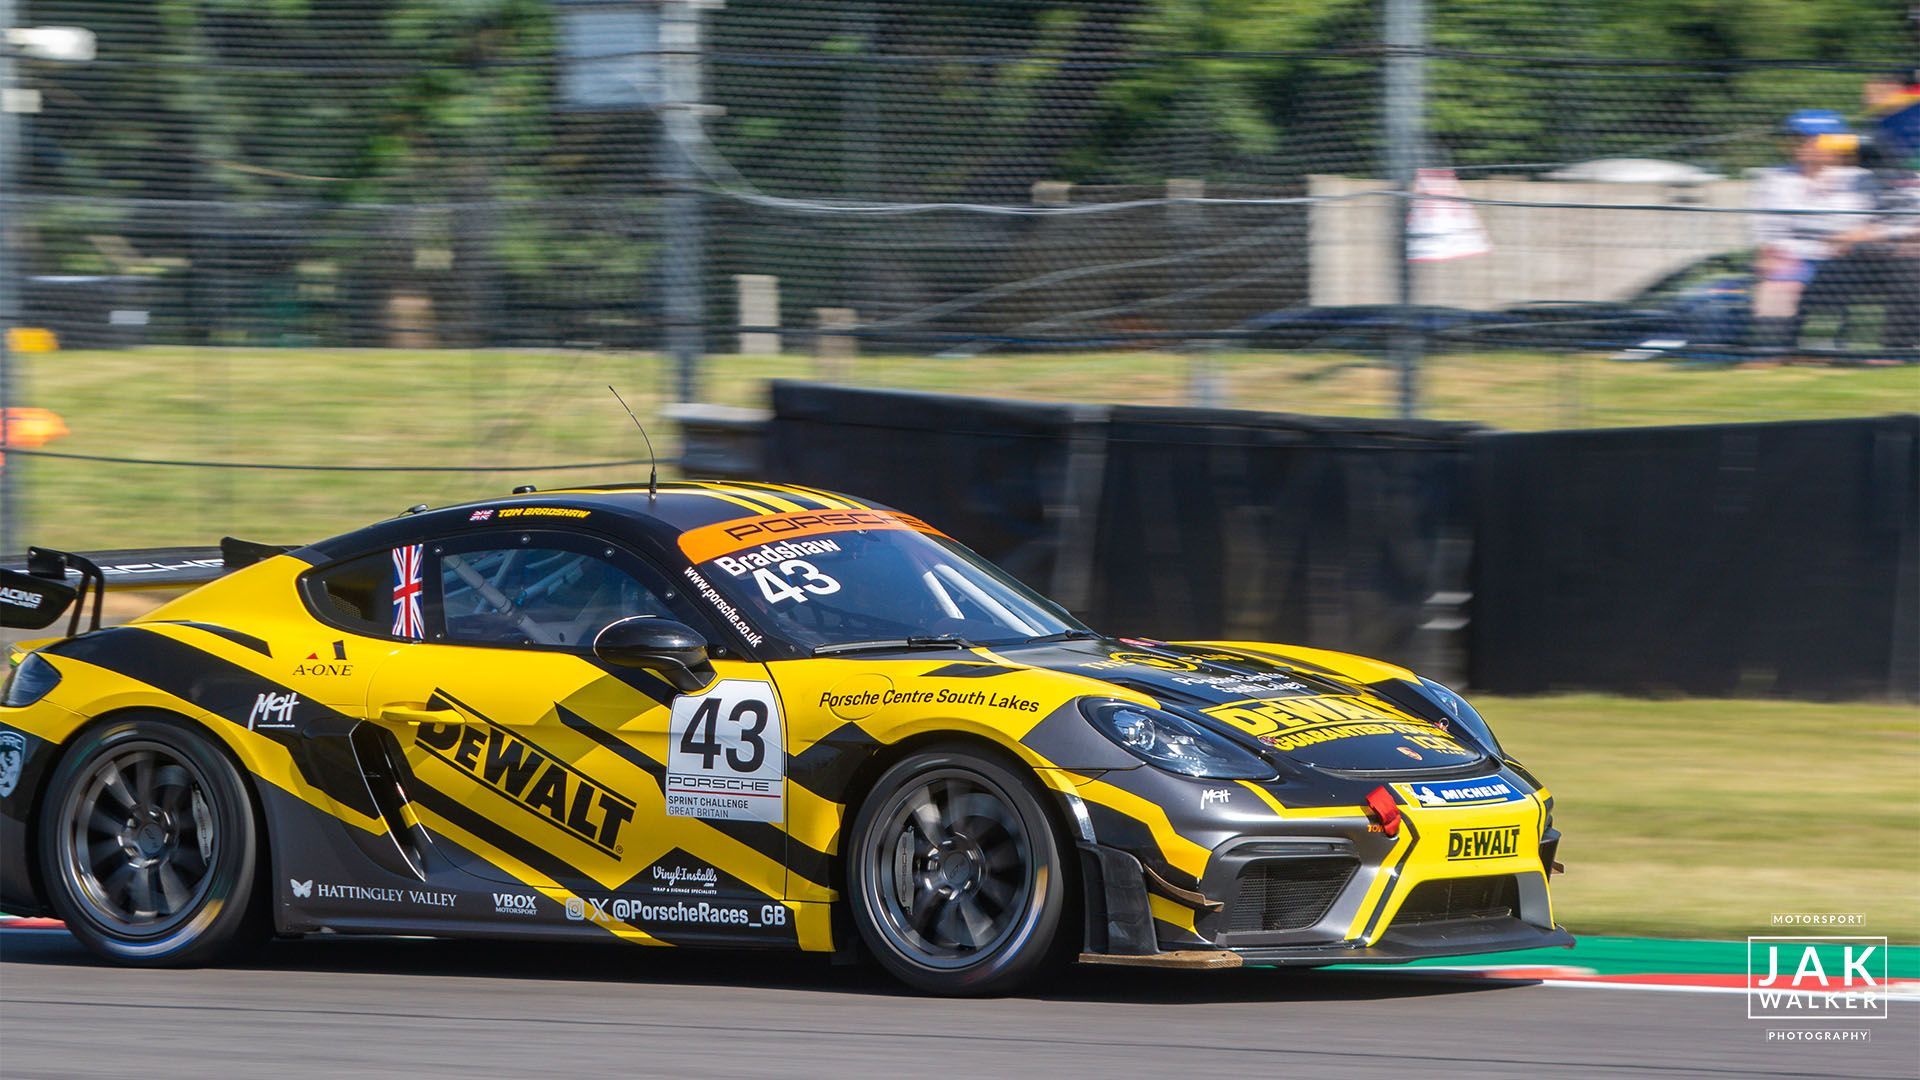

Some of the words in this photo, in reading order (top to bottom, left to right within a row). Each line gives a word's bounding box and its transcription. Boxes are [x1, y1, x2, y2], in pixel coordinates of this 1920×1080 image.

[498, 508, 523, 518] TOM
[523, 507, 592, 519] BRADSHAW
[724, 513, 932, 541] PORSCHE
[713, 538, 842, 578] Bradshaw
[751, 559, 842, 605] 43
[0, 586, 43, 605] ACING
[684, 566, 764, 649] www.porsche.co.uk
[292, 664, 354, 677] A-ONE
[819, 690, 880, 708] Porsche
[882, 689, 934, 705] Centre
[936, 689, 986, 706] South
[988, 692, 1040, 713] Lakes
[680, 697, 769, 773] 43
[1273, 722, 1396, 751] GUARANTEED
[1403, 735, 1466, 751] 100
[668, 776, 769, 791] PORSCHE
[1440, 783, 1511, 801] MICHELIN
[668, 796, 698, 806] SPRINT
[700, 797, 749, 809] CHALLENGE
[669, 806, 697, 816] GREAT
[697, 808, 729, 818] BRITAIN
[653, 866, 718, 886] Vinyl-Installs
[318, 884, 404, 902] HATTINGLEY
[408, 890, 457, 907] VALLEY
[492, 893, 537, 909] VBOX
[495, 906, 538, 915] MOTORSPORT
[612, 899, 786, 927] @PorscheRaces_GB
